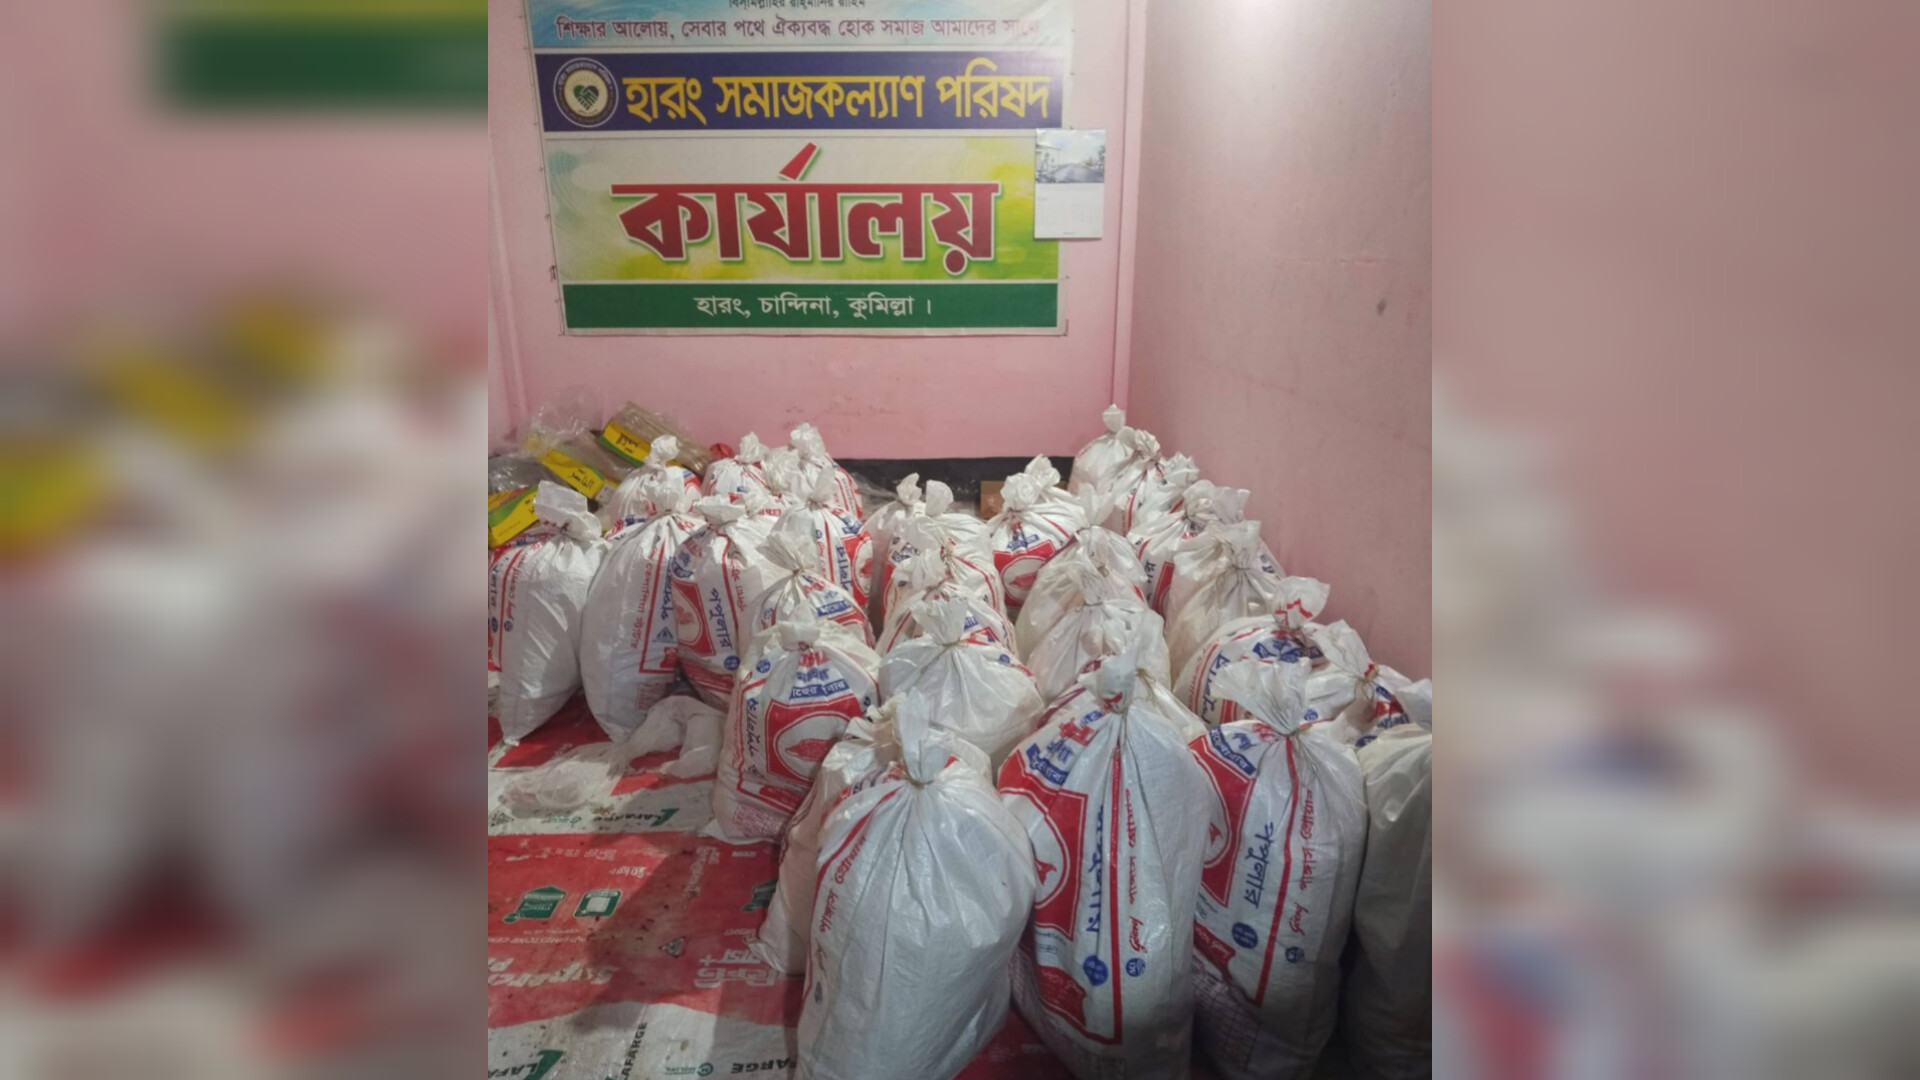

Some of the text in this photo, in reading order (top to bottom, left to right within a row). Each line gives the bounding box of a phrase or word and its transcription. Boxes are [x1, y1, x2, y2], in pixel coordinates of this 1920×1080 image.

[556, 15, 606, 38] শিক্ষার
[612, 19, 675, 40] আলোয়,
[681, 19, 727, 38] সেবার
[734, 19, 765, 37] পথে
[772, 13, 831, 38] ঐক্যবদ্ধ
[838, 19, 875, 38] হোক
[881, 19, 925, 37] সমাজ
[930, 19, 996, 37] আমাদের
[622, 76, 708, 126] হারং
[712, 75, 926, 119] সমাজকল্যাণ
[935, 57, 1052, 119] পরিষদ
[610, 141, 1001, 276] কার্যালয়
[694, 295, 751, 318] হারং,
[760, 291, 838, 318] চান্দিনা,
[847, 291, 915, 320] কুমিল্লা
[1242, 822, 1275, 910] পপুলার
